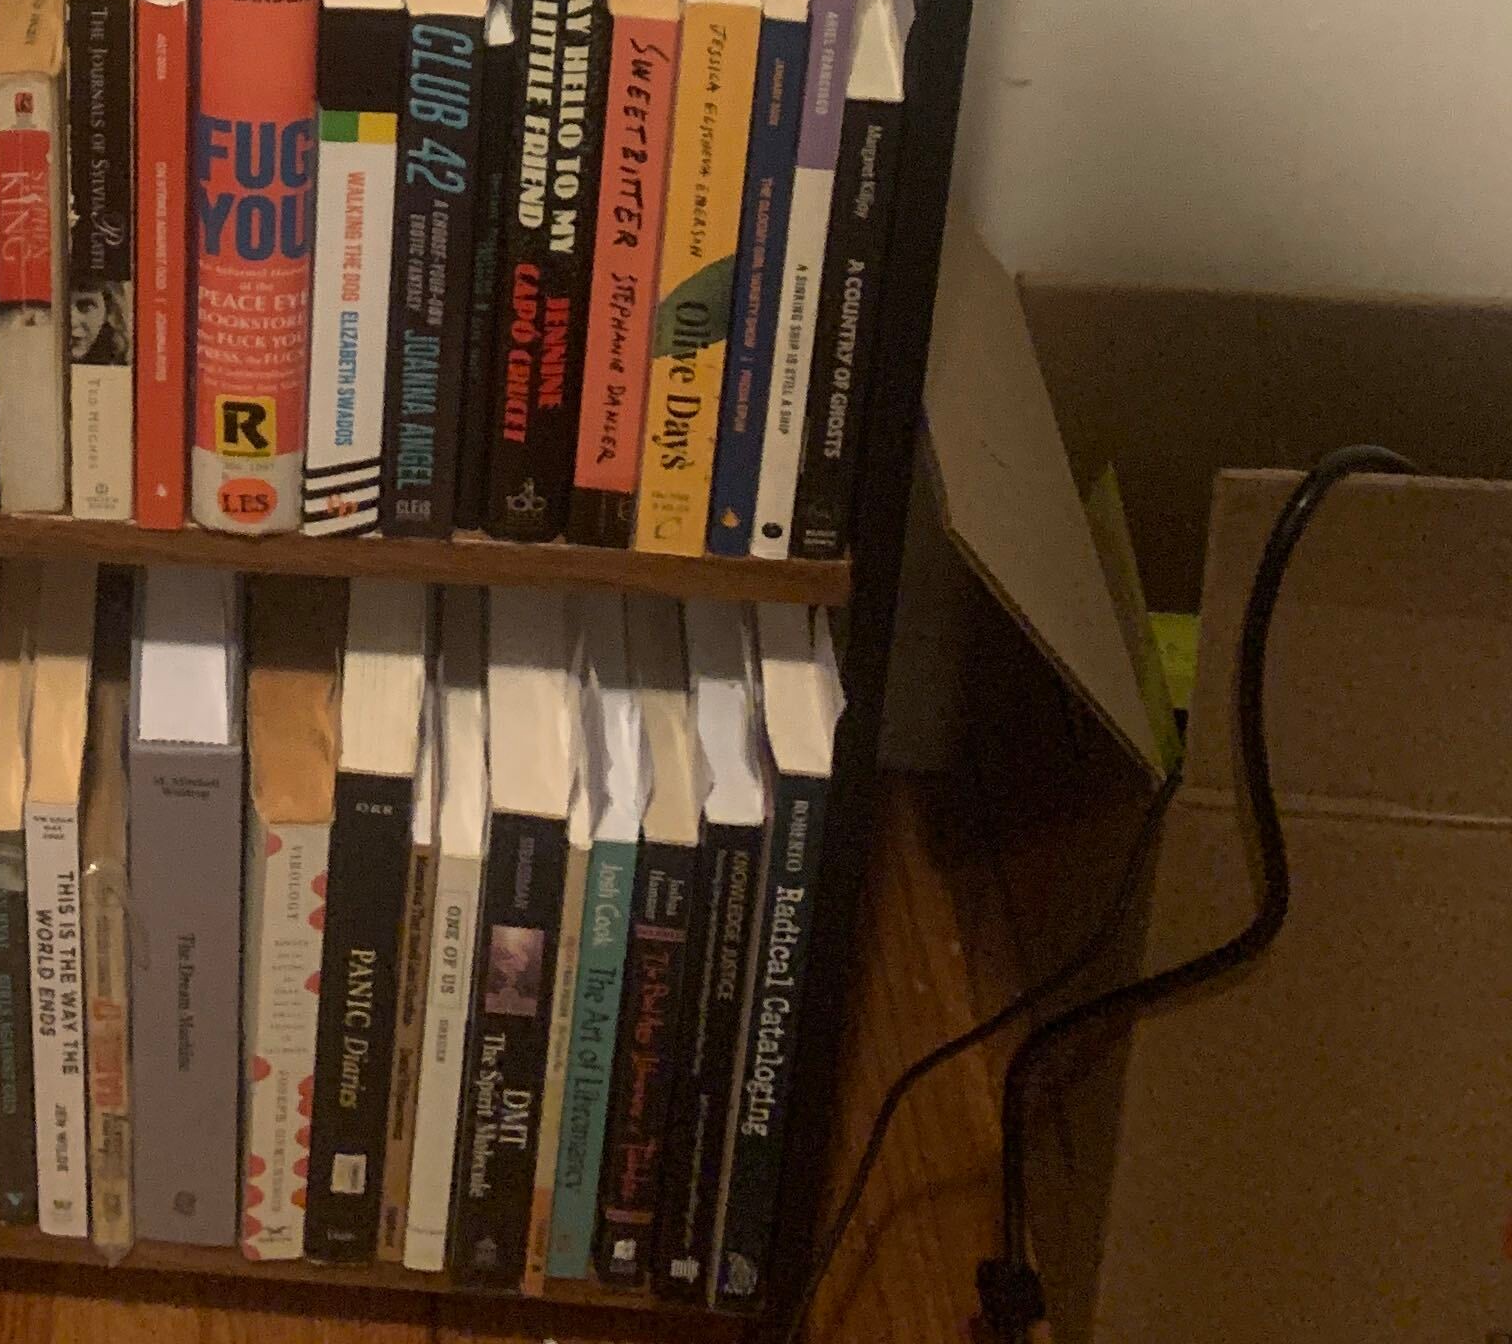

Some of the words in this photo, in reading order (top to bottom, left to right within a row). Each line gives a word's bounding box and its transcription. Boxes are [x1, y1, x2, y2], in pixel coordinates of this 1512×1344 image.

[408, 22, 475, 132] CLUB
[406, 141, 466, 196] 42
[614, 38, 670, 250] SWEETBITTER
[35, 908, 55, 981] WORLD
[763, 885, 805, 988] Radical
[38, 990, 57, 1039] ENDS
[344, 947, 376, 1029] PANIC
[740, 997, 791, 1138] Cataloging
